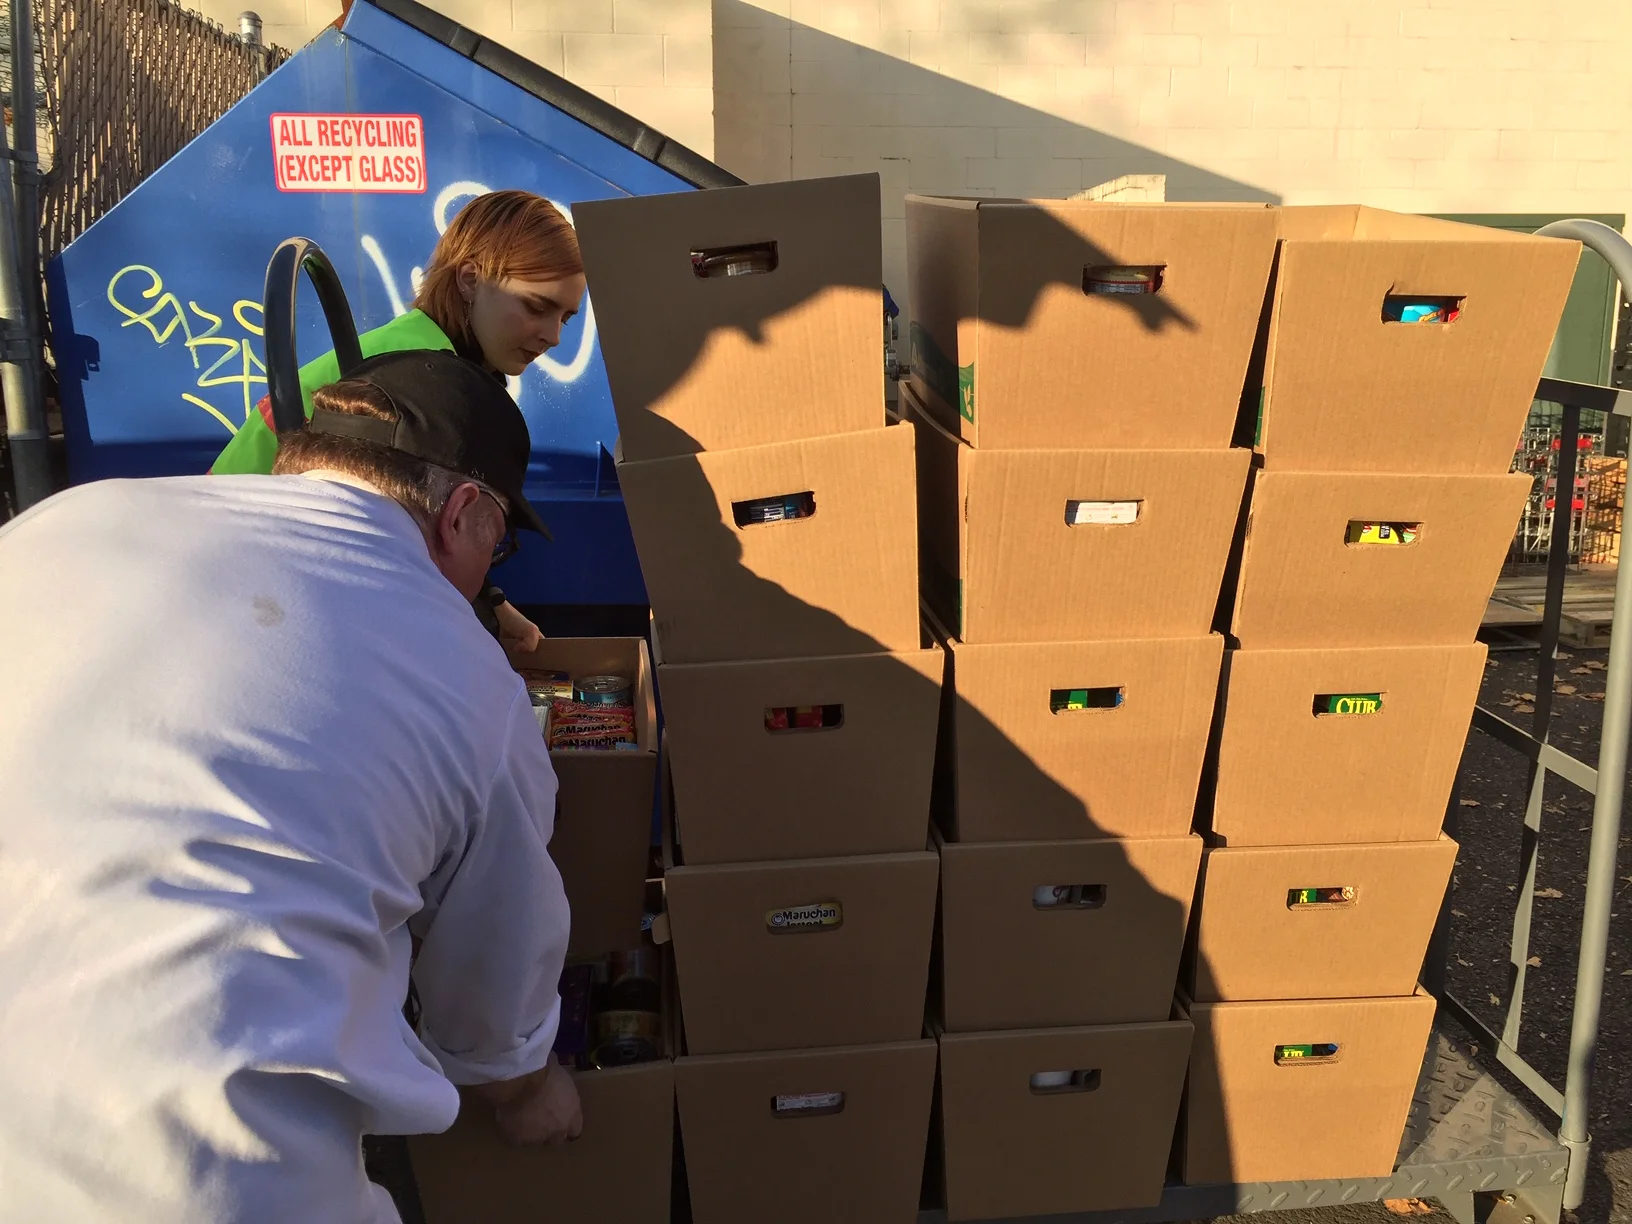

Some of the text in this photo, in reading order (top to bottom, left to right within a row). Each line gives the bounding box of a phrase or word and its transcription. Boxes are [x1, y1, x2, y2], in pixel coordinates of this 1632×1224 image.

[279, 119, 417, 147] ALL RECYCLING
[279, 154, 423, 189] (EXCEPT GLASS)
[782, 908, 836, 920] Maruchan
